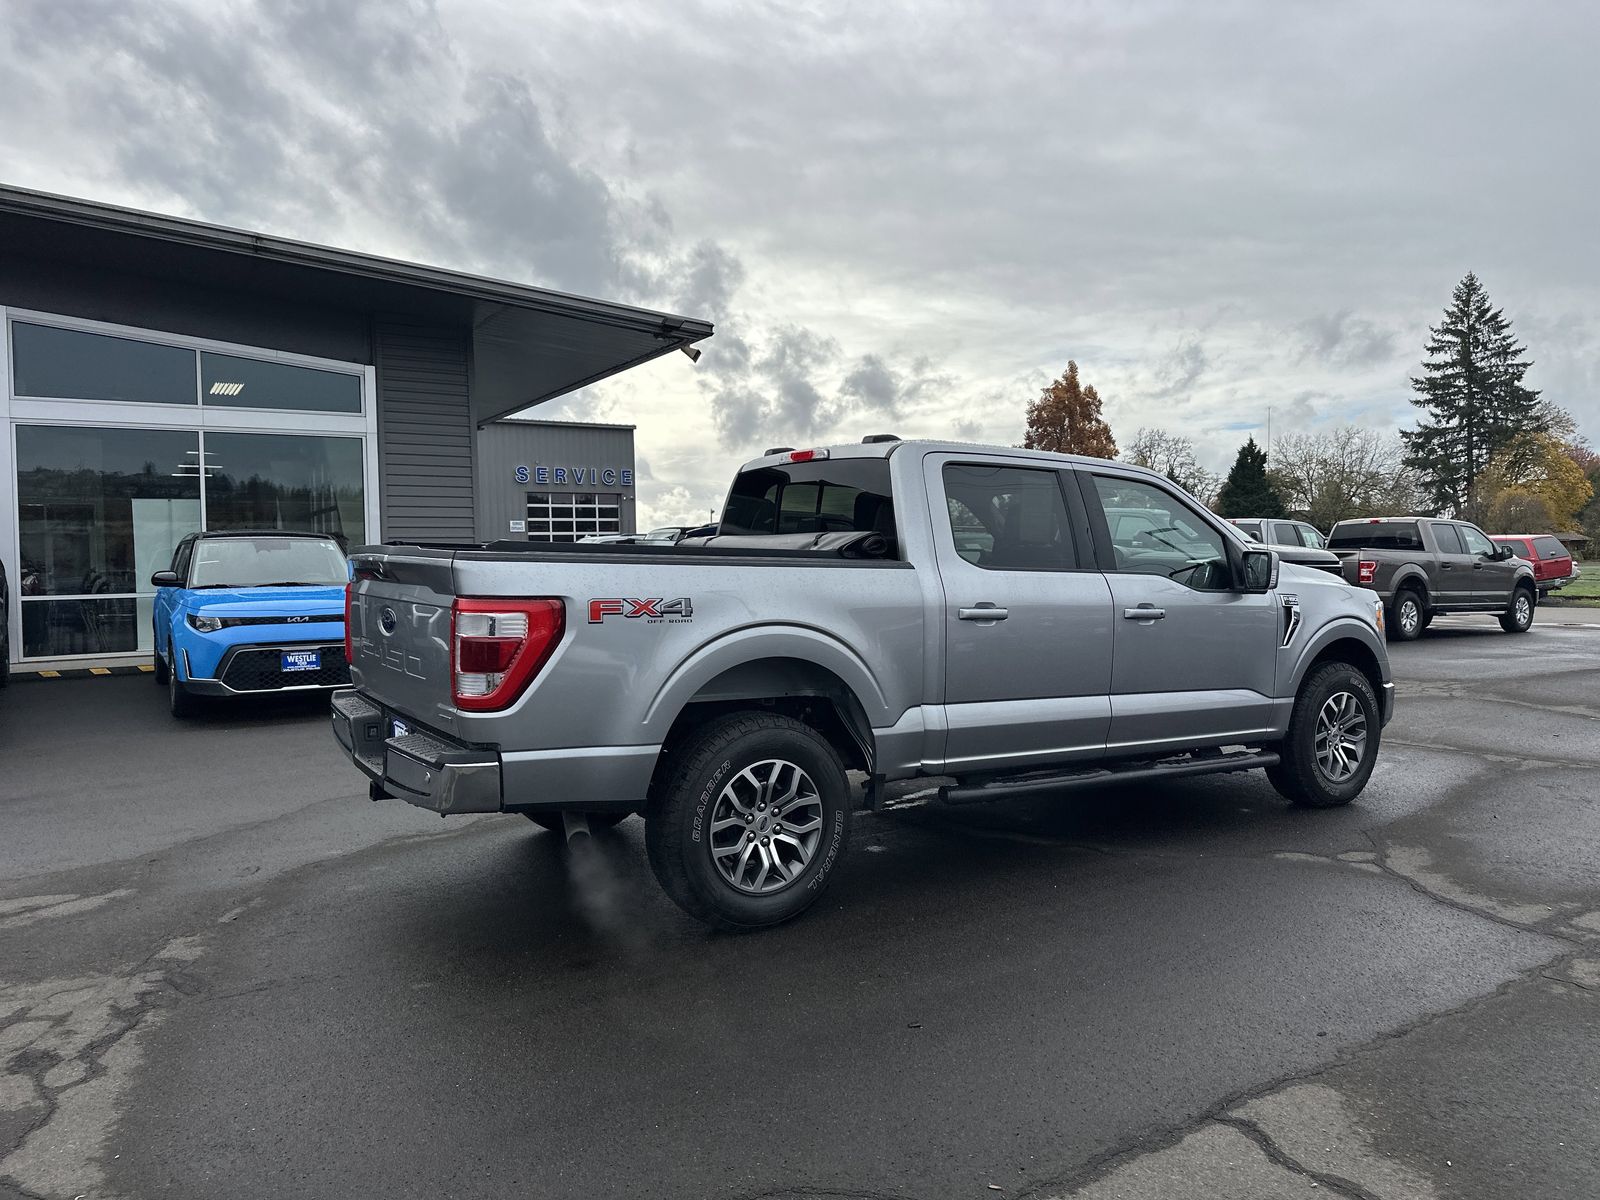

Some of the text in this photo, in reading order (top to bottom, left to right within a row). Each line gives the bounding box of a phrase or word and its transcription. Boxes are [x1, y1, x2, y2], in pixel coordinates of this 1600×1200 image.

[515, 465, 633, 486] SERVICE
[587, 598, 693, 624] FX4
[286, 654, 317, 662] WESTLIE
[692, 760, 732, 842] GRABBER
[807, 810, 844, 890] GENERAL
